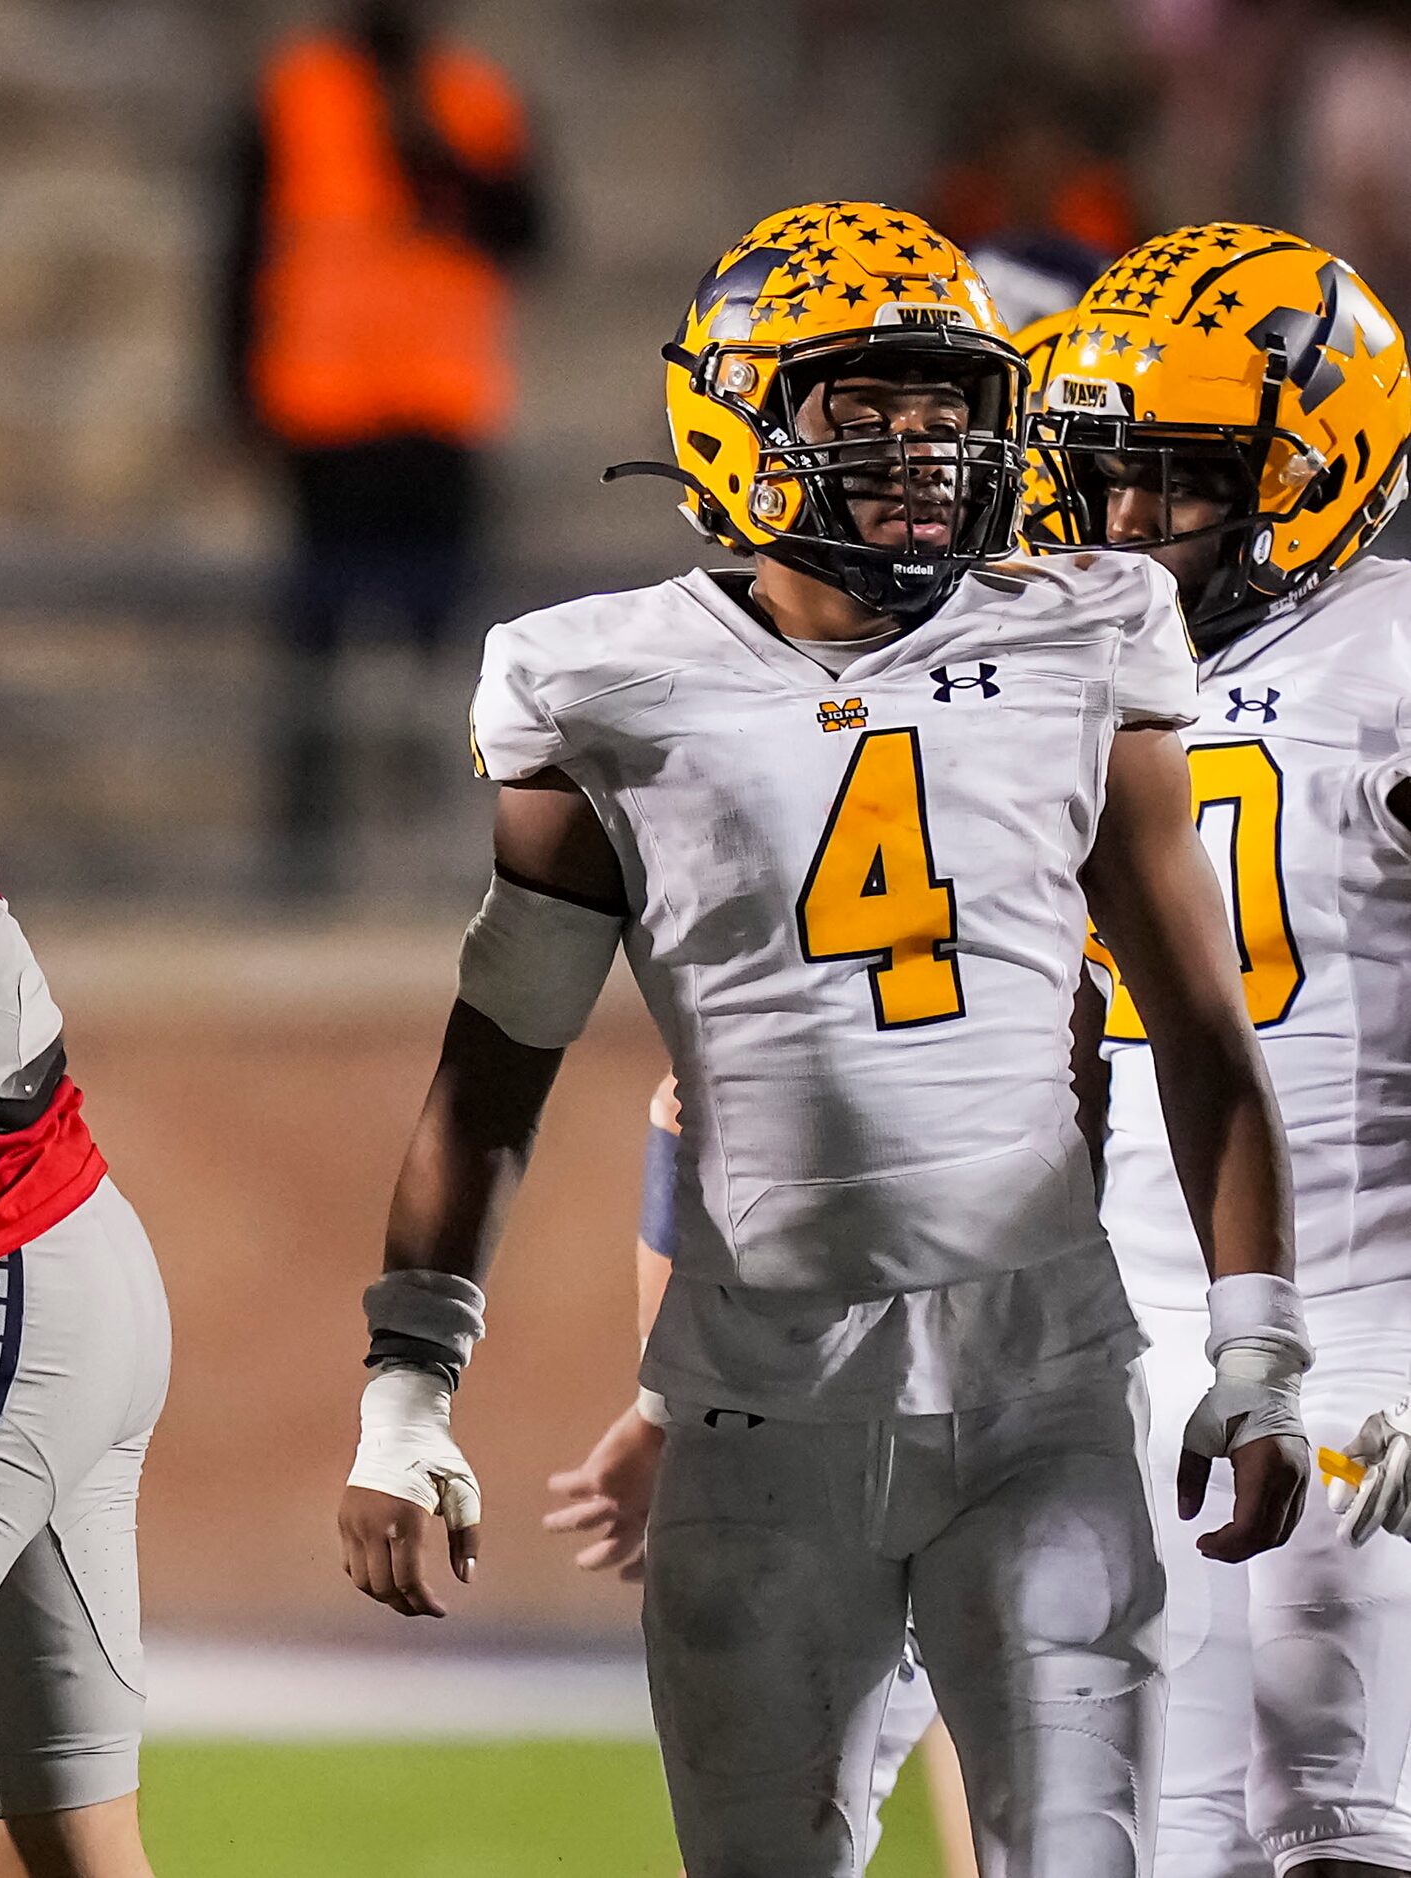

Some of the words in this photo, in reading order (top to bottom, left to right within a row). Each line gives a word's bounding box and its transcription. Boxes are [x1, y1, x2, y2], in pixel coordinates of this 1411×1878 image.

[893, 563, 934, 575] Riddell
[819, 709, 867, 721] LIONS
[796, 726, 967, 1031] 4
